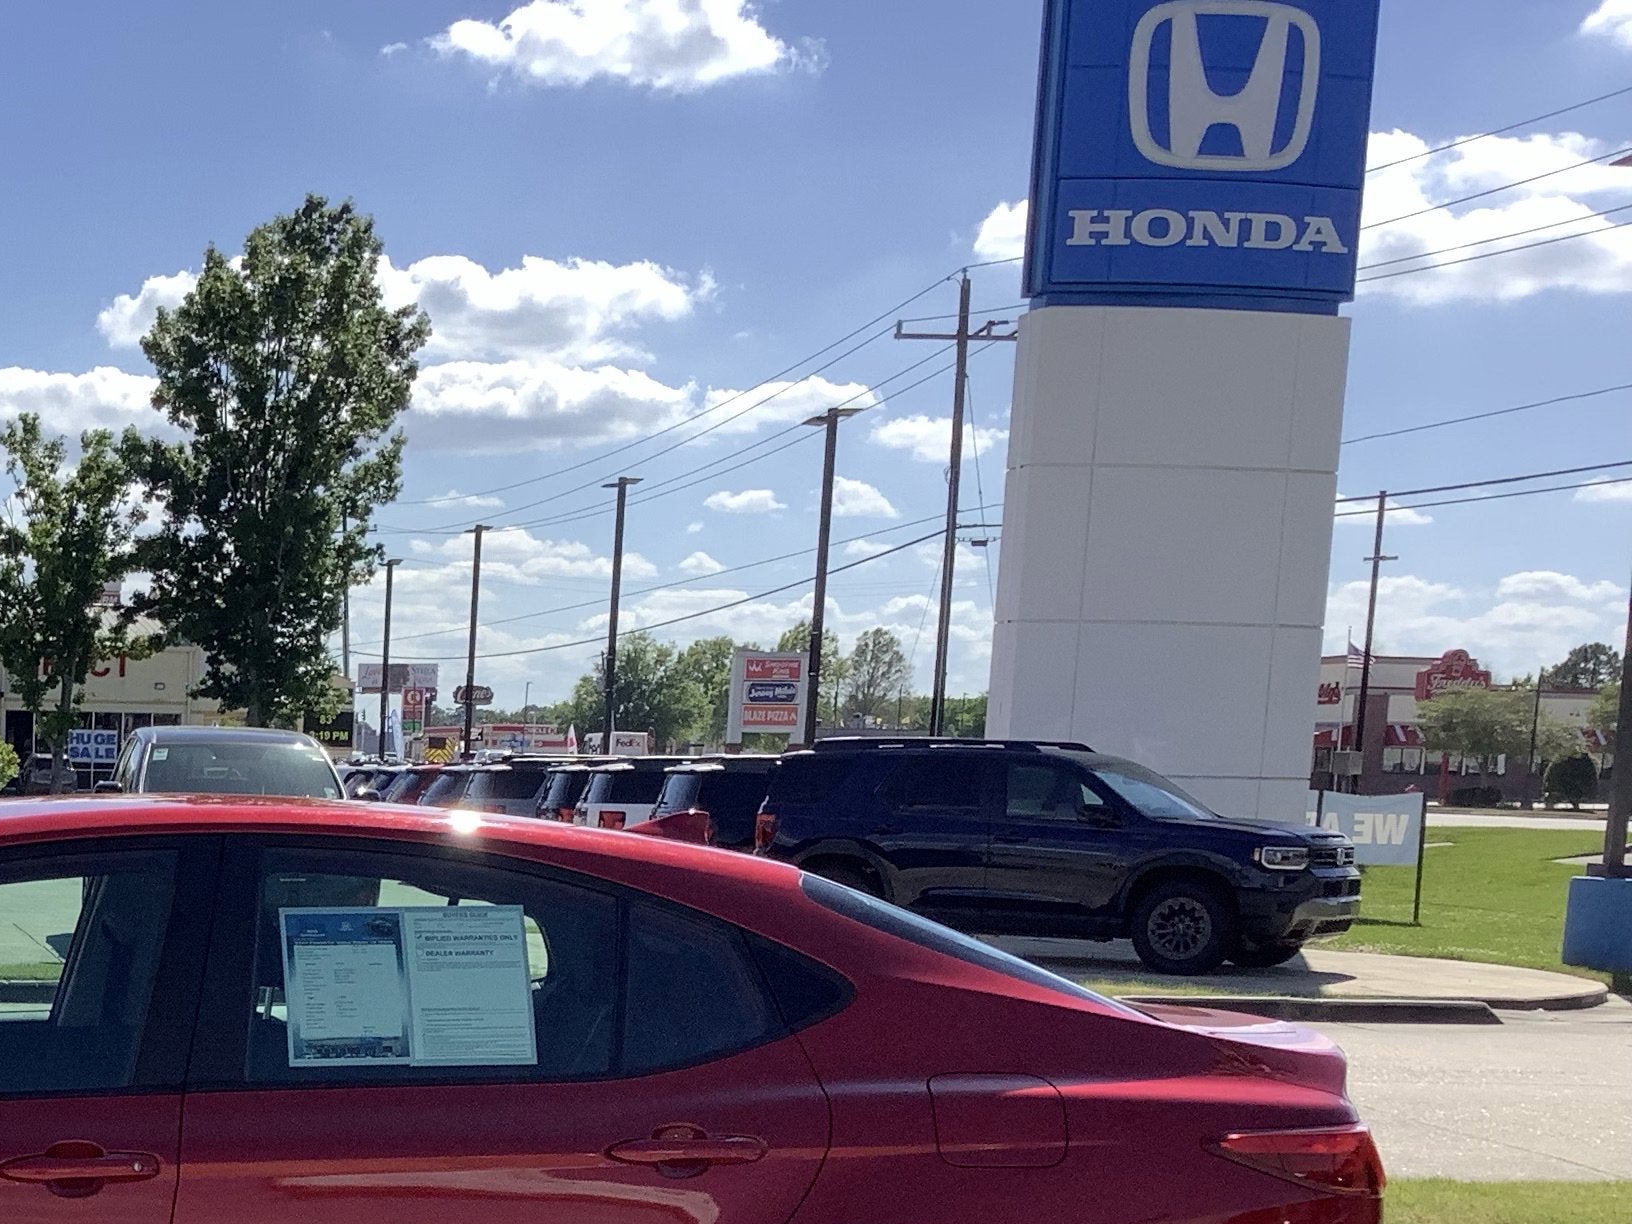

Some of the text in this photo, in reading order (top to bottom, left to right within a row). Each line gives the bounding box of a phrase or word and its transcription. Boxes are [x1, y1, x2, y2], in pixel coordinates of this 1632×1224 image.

[1066, 208, 1349, 254] HONDA
[767, 711, 788, 721] PIZZA
[70, 733, 117, 745] HUGE
[332, 731, 348, 740] PM
[70, 747, 115, 758] SALE
[455, 949, 494, 957] WARRANTY
